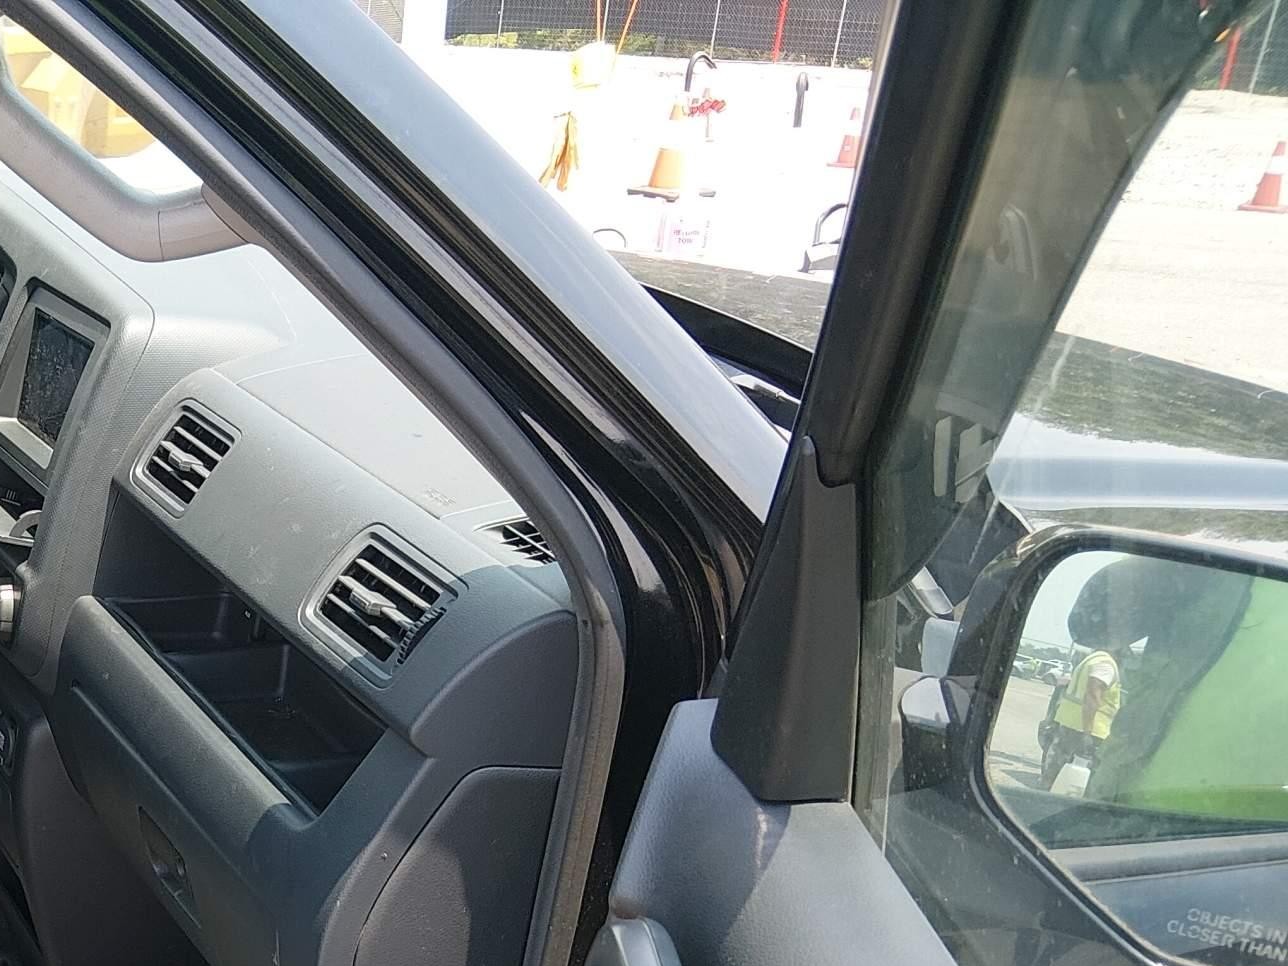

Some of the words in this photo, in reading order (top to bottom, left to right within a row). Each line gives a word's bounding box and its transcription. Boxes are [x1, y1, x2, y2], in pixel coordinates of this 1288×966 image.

[1167, 919, 1236, 949] CLOSER
[1239, 938, 1288, 962] THAN
[1186, 908, 1263, 939] OBJECTS
